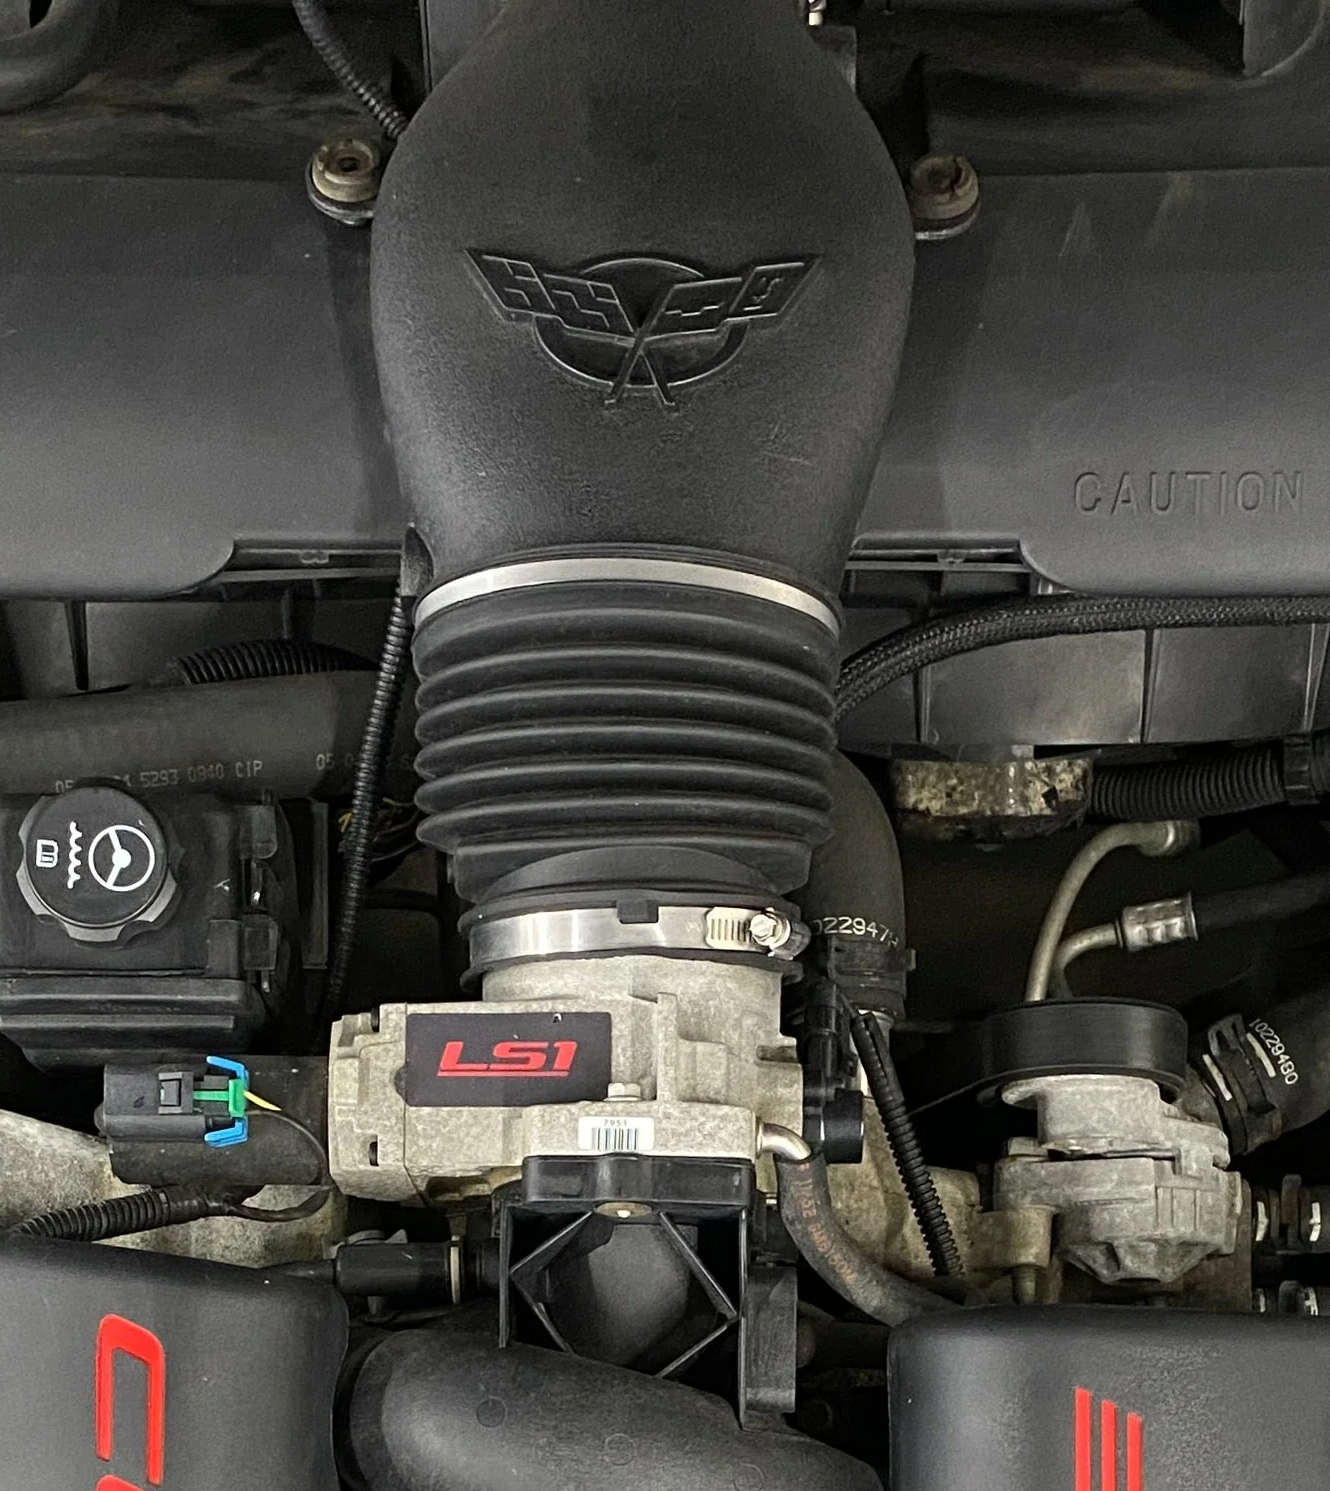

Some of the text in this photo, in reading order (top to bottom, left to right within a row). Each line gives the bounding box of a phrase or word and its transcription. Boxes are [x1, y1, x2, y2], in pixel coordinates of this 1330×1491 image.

[1074, 471, 1303, 516] CAUTION
[139, 767, 179, 787] 5293
[234, 759, 263, 778] CIP
[439, 1041, 577, 1073] LS1
